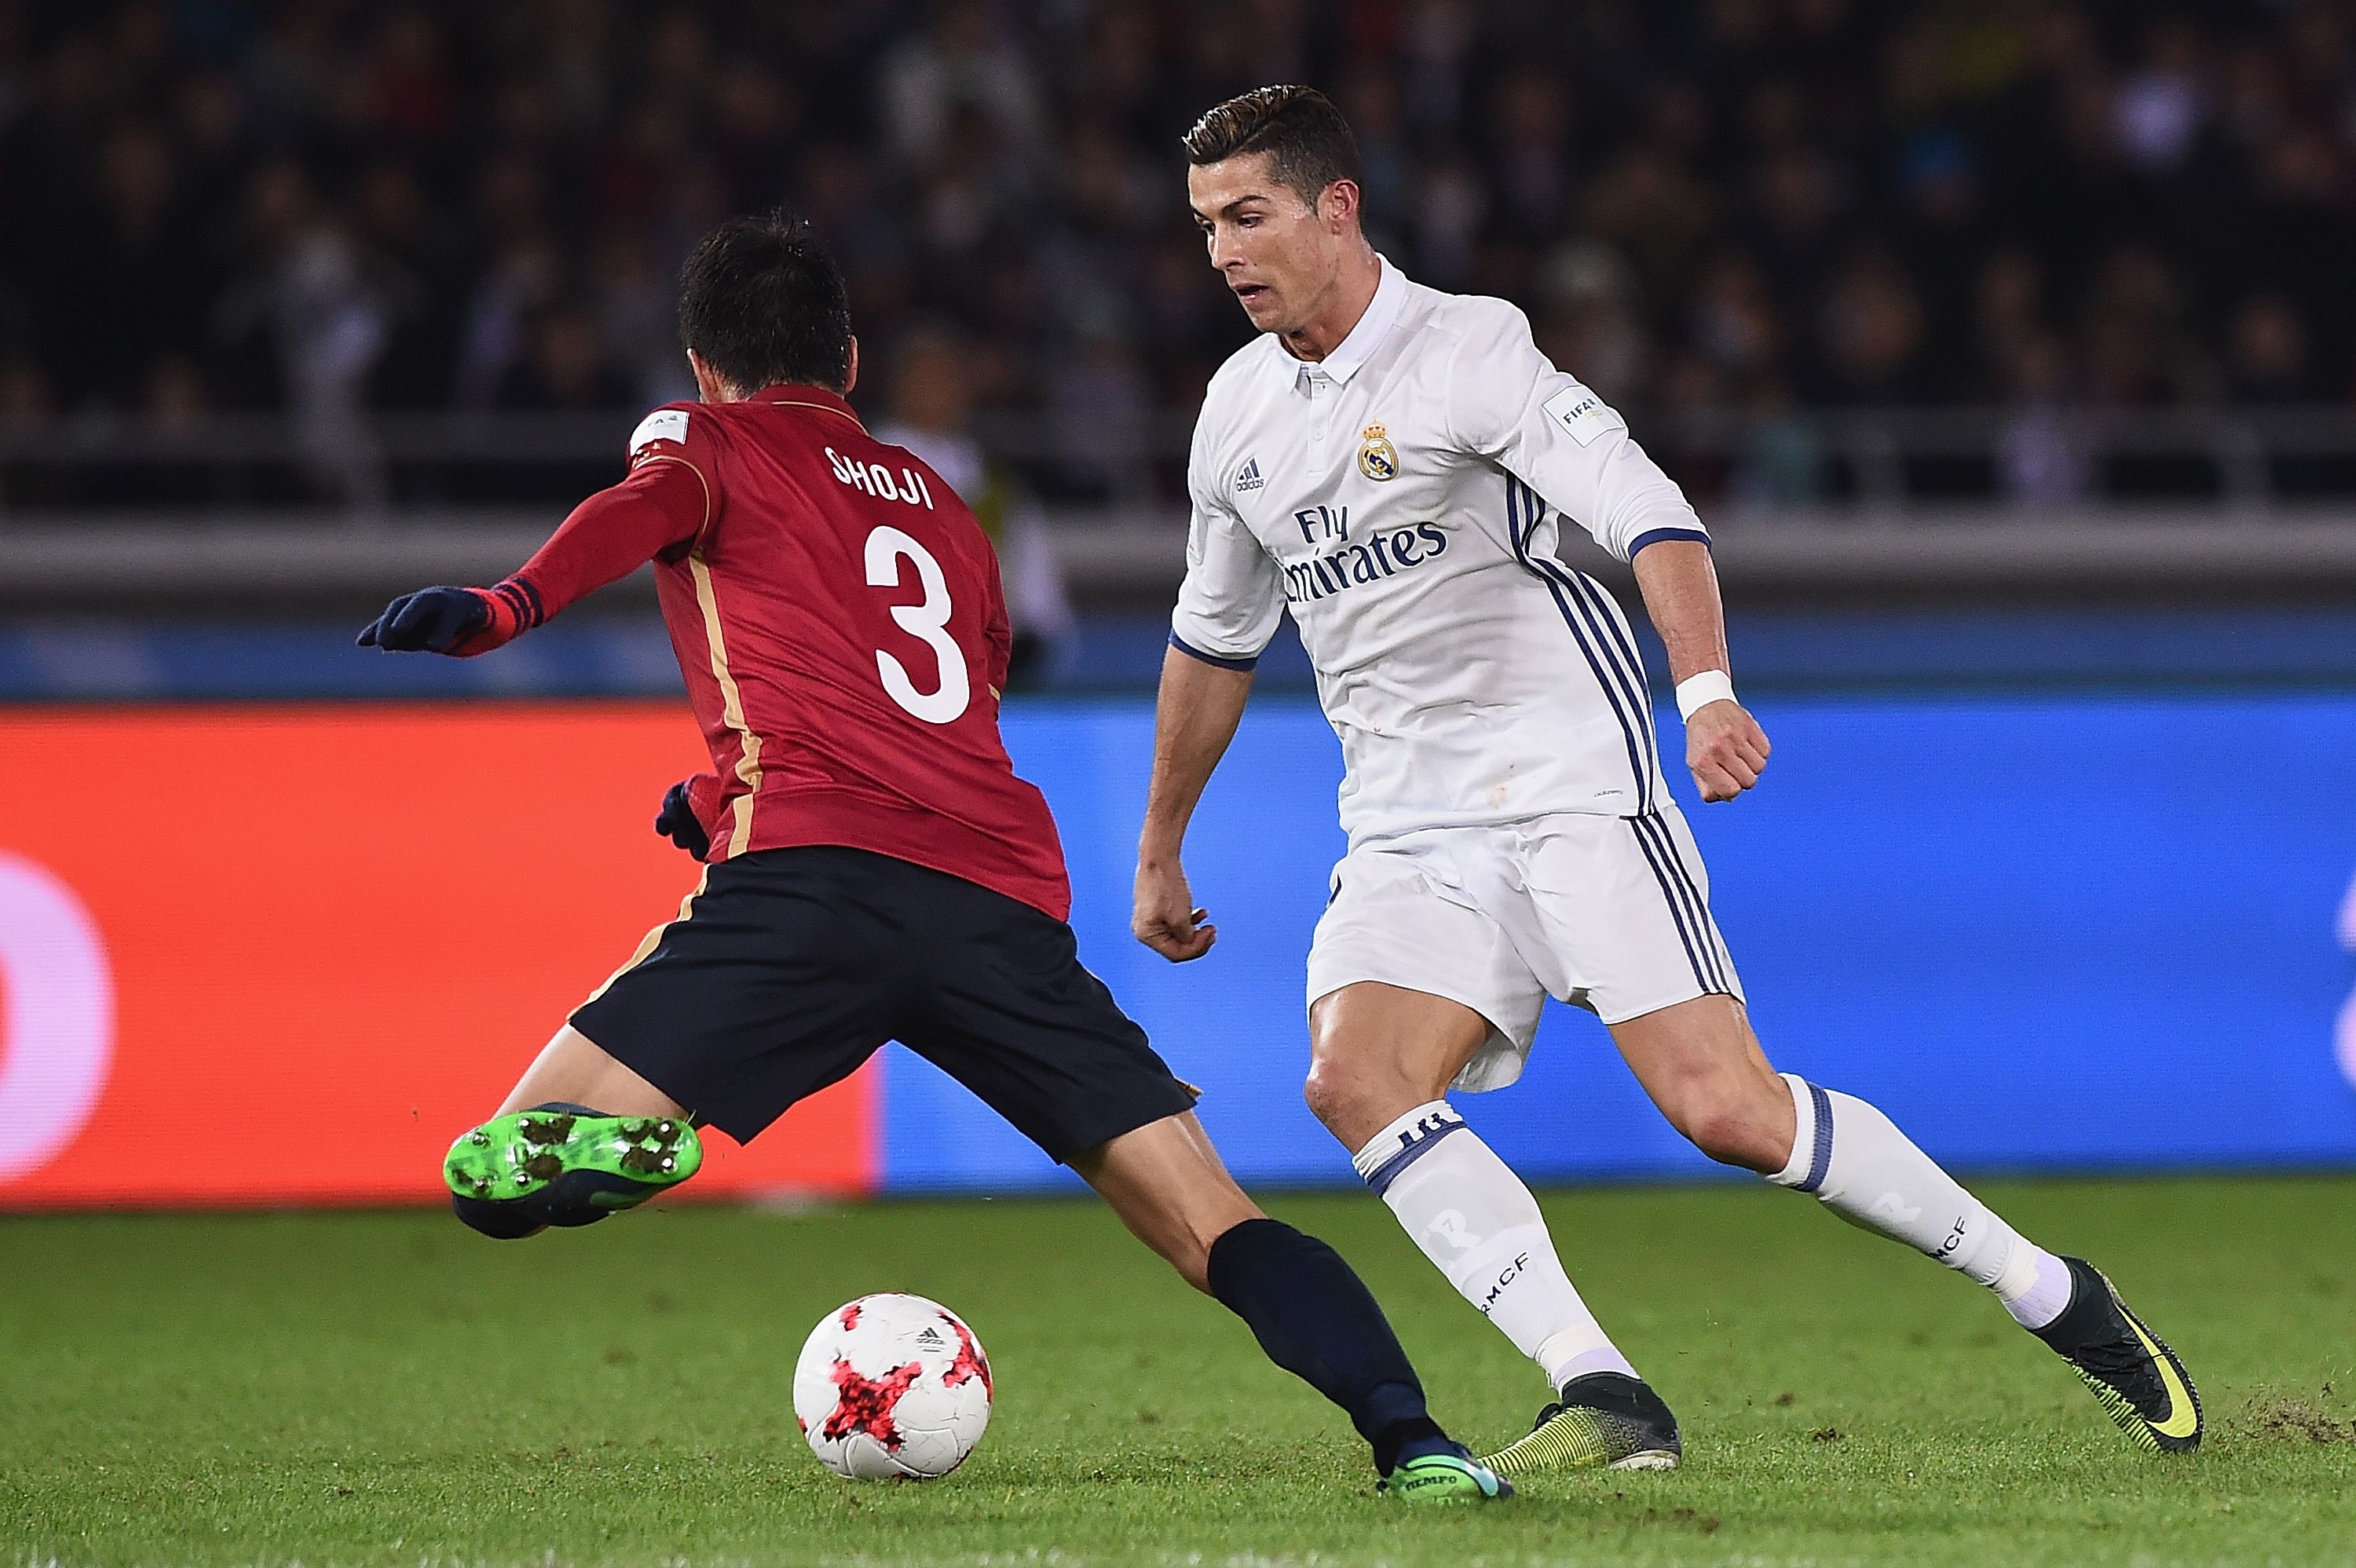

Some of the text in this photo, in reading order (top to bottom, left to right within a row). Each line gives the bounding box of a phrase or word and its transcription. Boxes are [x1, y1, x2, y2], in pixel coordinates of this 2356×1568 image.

[825, 446, 934, 510] SHOJI
[1236, 477, 1264, 492] adidas
[1294, 505, 1348, 544] Fly
[1285, 521, 1447, 602] mirates
[865, 525, 971, 724] 3
[1480, 1252, 1528, 1318] RMCF
